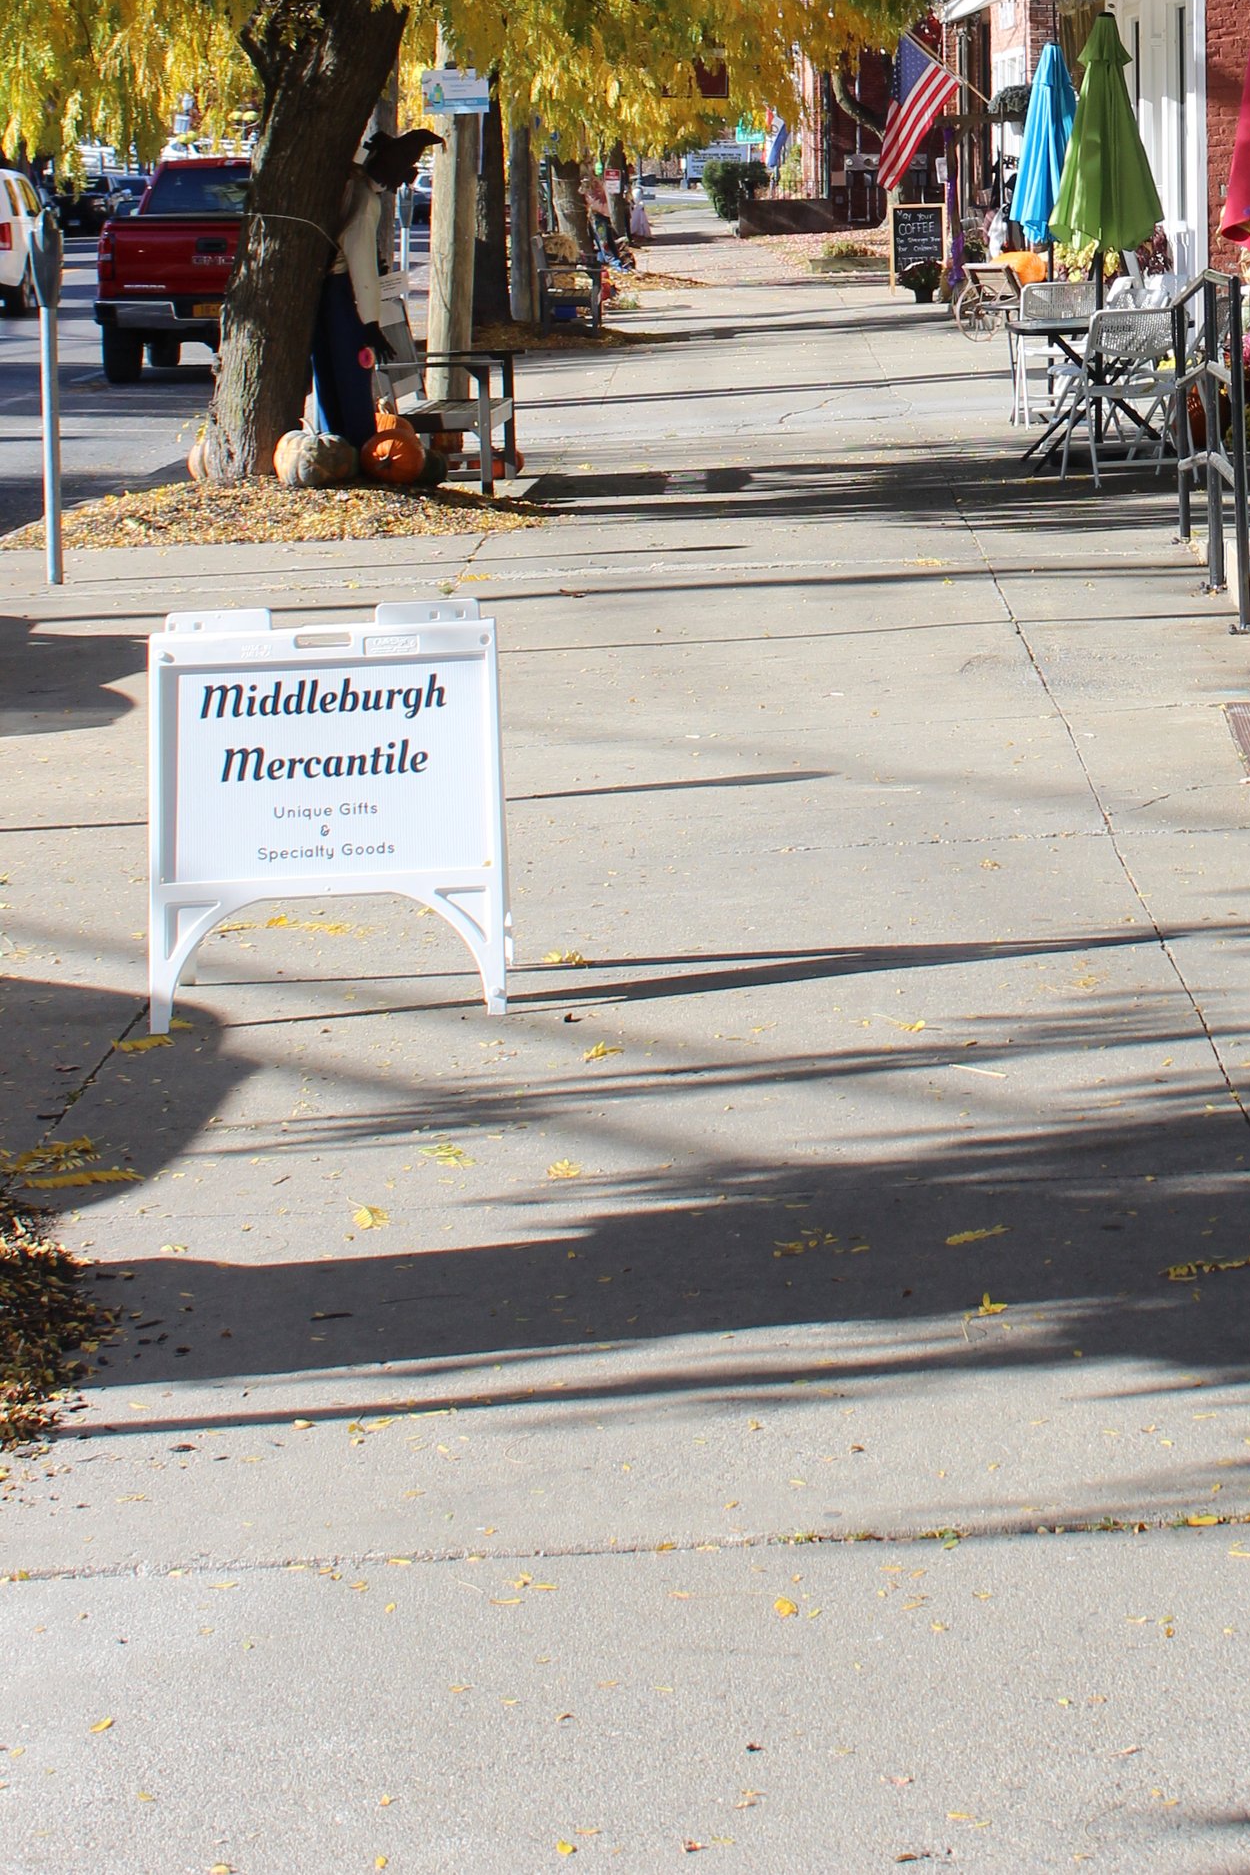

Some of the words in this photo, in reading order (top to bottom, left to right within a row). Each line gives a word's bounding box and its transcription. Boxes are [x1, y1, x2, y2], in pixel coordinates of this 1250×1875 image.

[898, 221, 935, 236] COFFEE
[200, 673, 447, 720] Middleburgh
[220, 738, 429, 783] Mercantile
[273, 803, 334, 820] Unique
[339, 801, 379, 817] Gifts
[319, 824, 331, 837] &
[257, 843, 335, 863] Specialty
[341, 841, 396, 857] Goods
